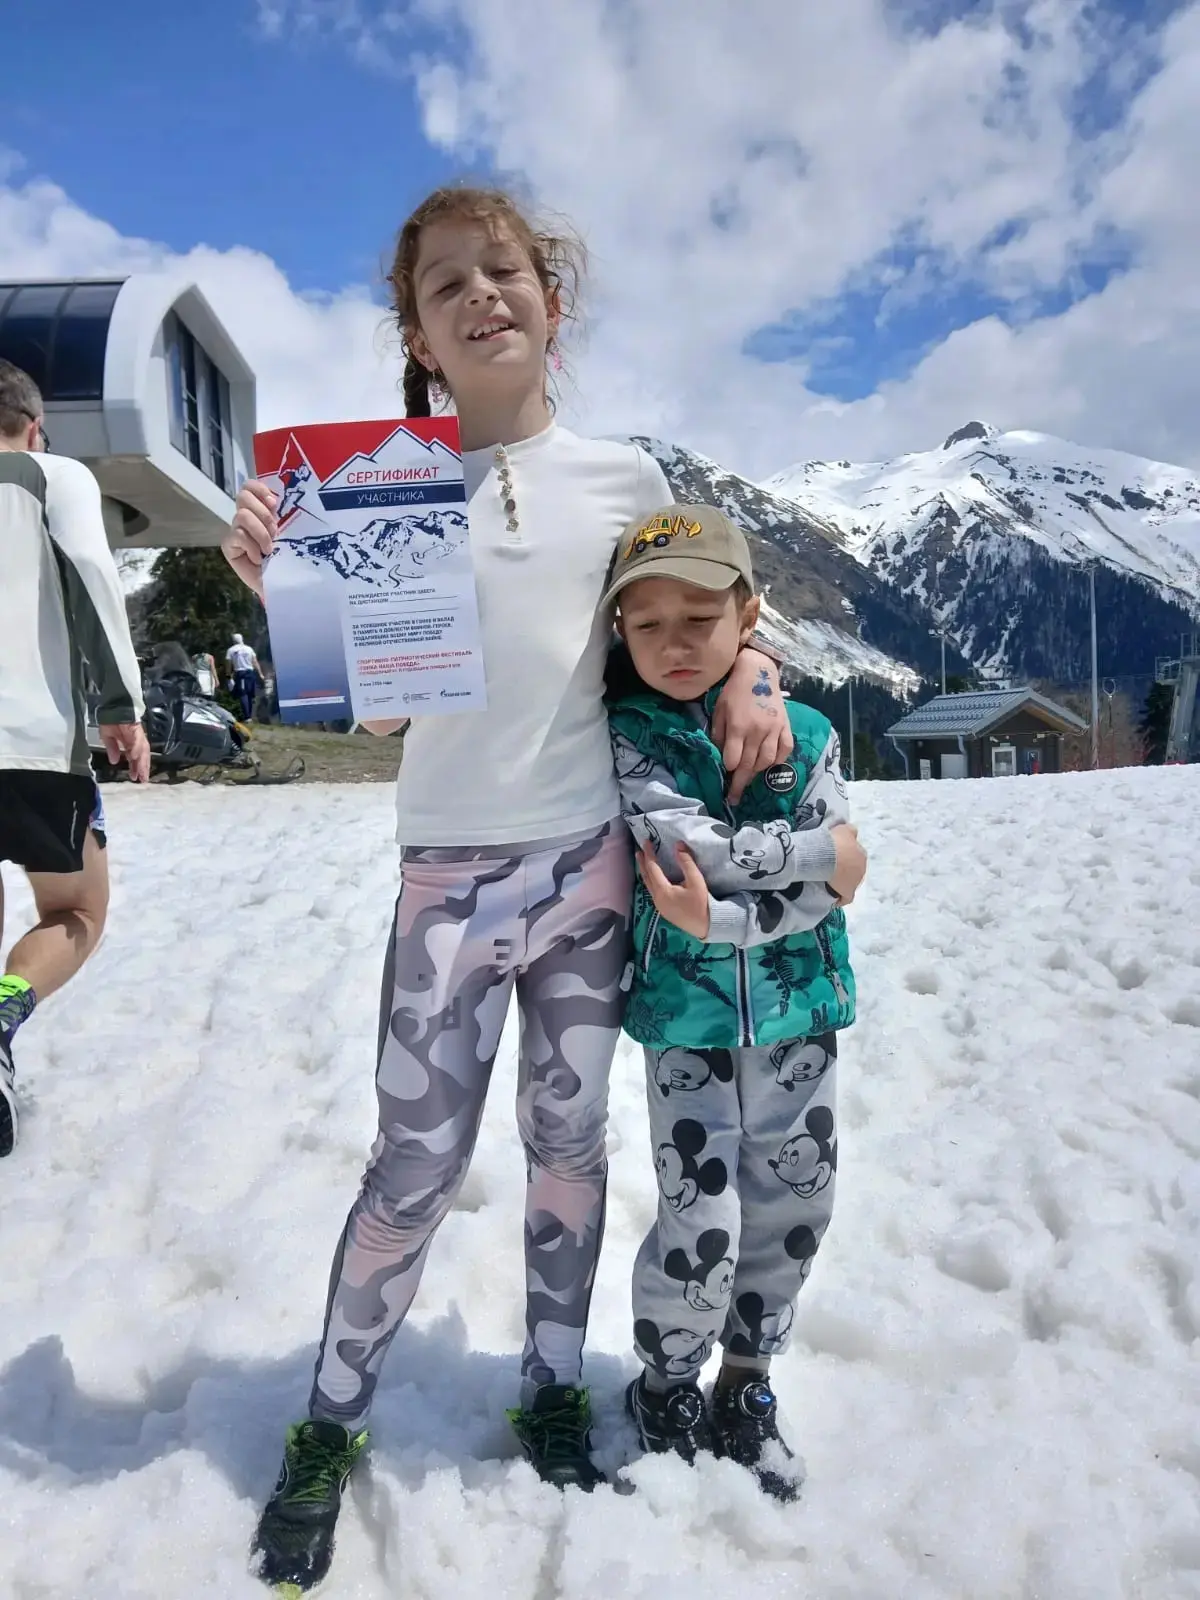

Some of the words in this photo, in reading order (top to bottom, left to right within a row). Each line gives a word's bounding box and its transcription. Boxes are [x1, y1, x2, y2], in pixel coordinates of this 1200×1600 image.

[347, 466, 440, 484] СЕРТИФИКАТ
[357, 491, 424, 504] УЧАСТНИКА
[768, 771, 794, 779] HYPER
